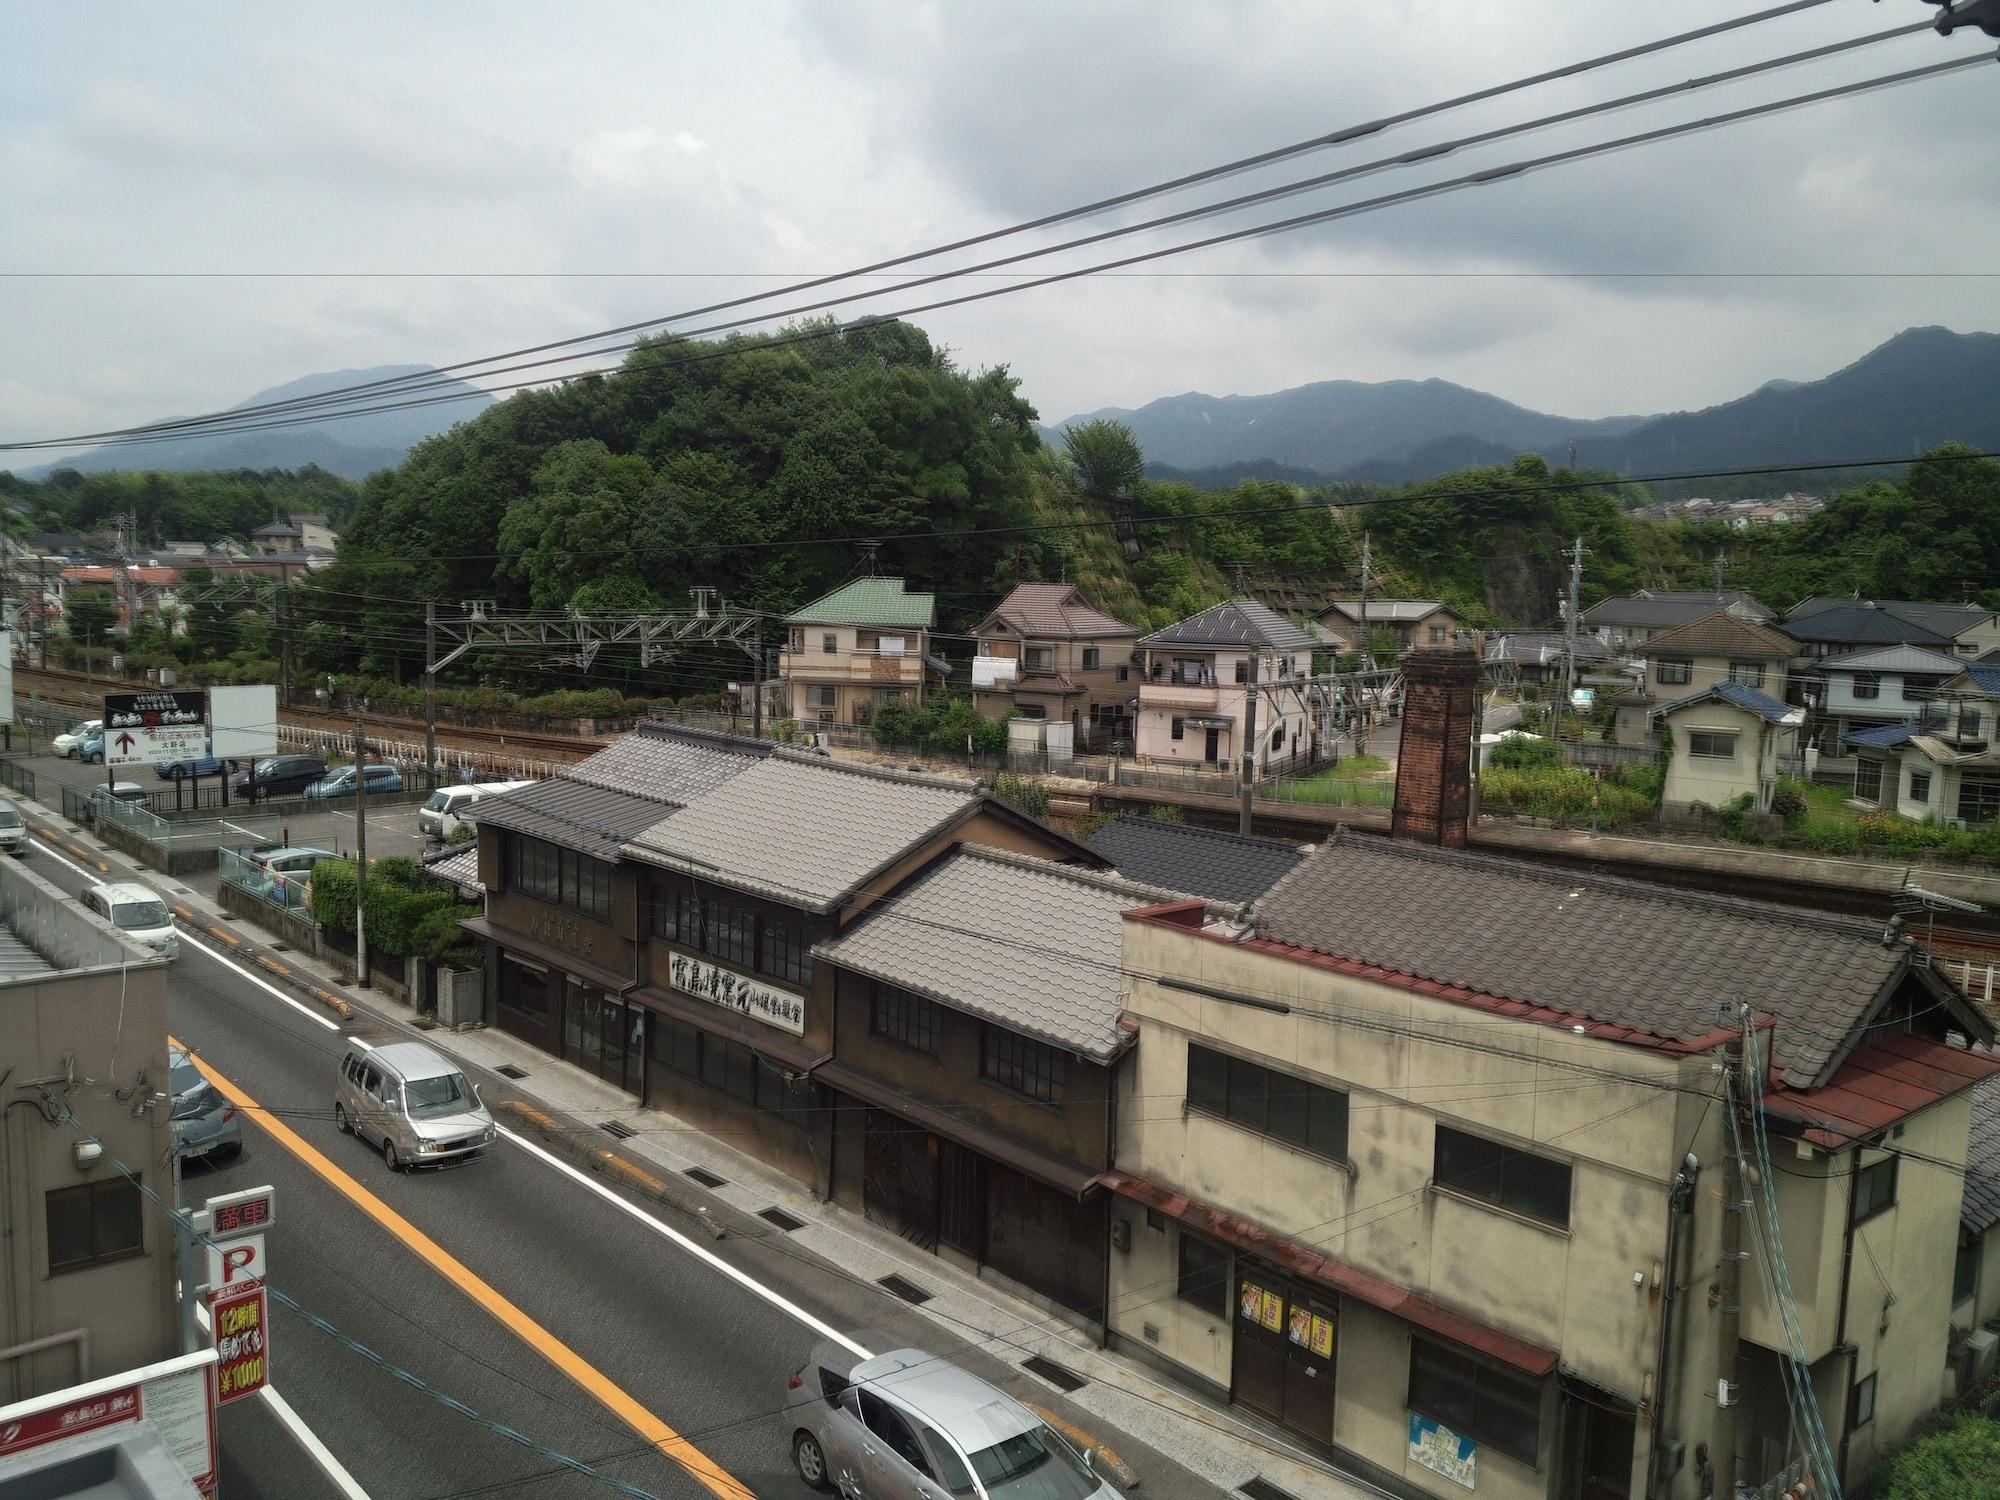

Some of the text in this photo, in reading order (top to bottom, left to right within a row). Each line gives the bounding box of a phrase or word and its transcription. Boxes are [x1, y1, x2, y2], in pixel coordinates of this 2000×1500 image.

[216, 1202, 266, 1232] 満車
[223, 1245, 256, 1283] P
[220, 1300, 259, 1338] 12時間
[219, 1355, 264, 1396] ¥1000
